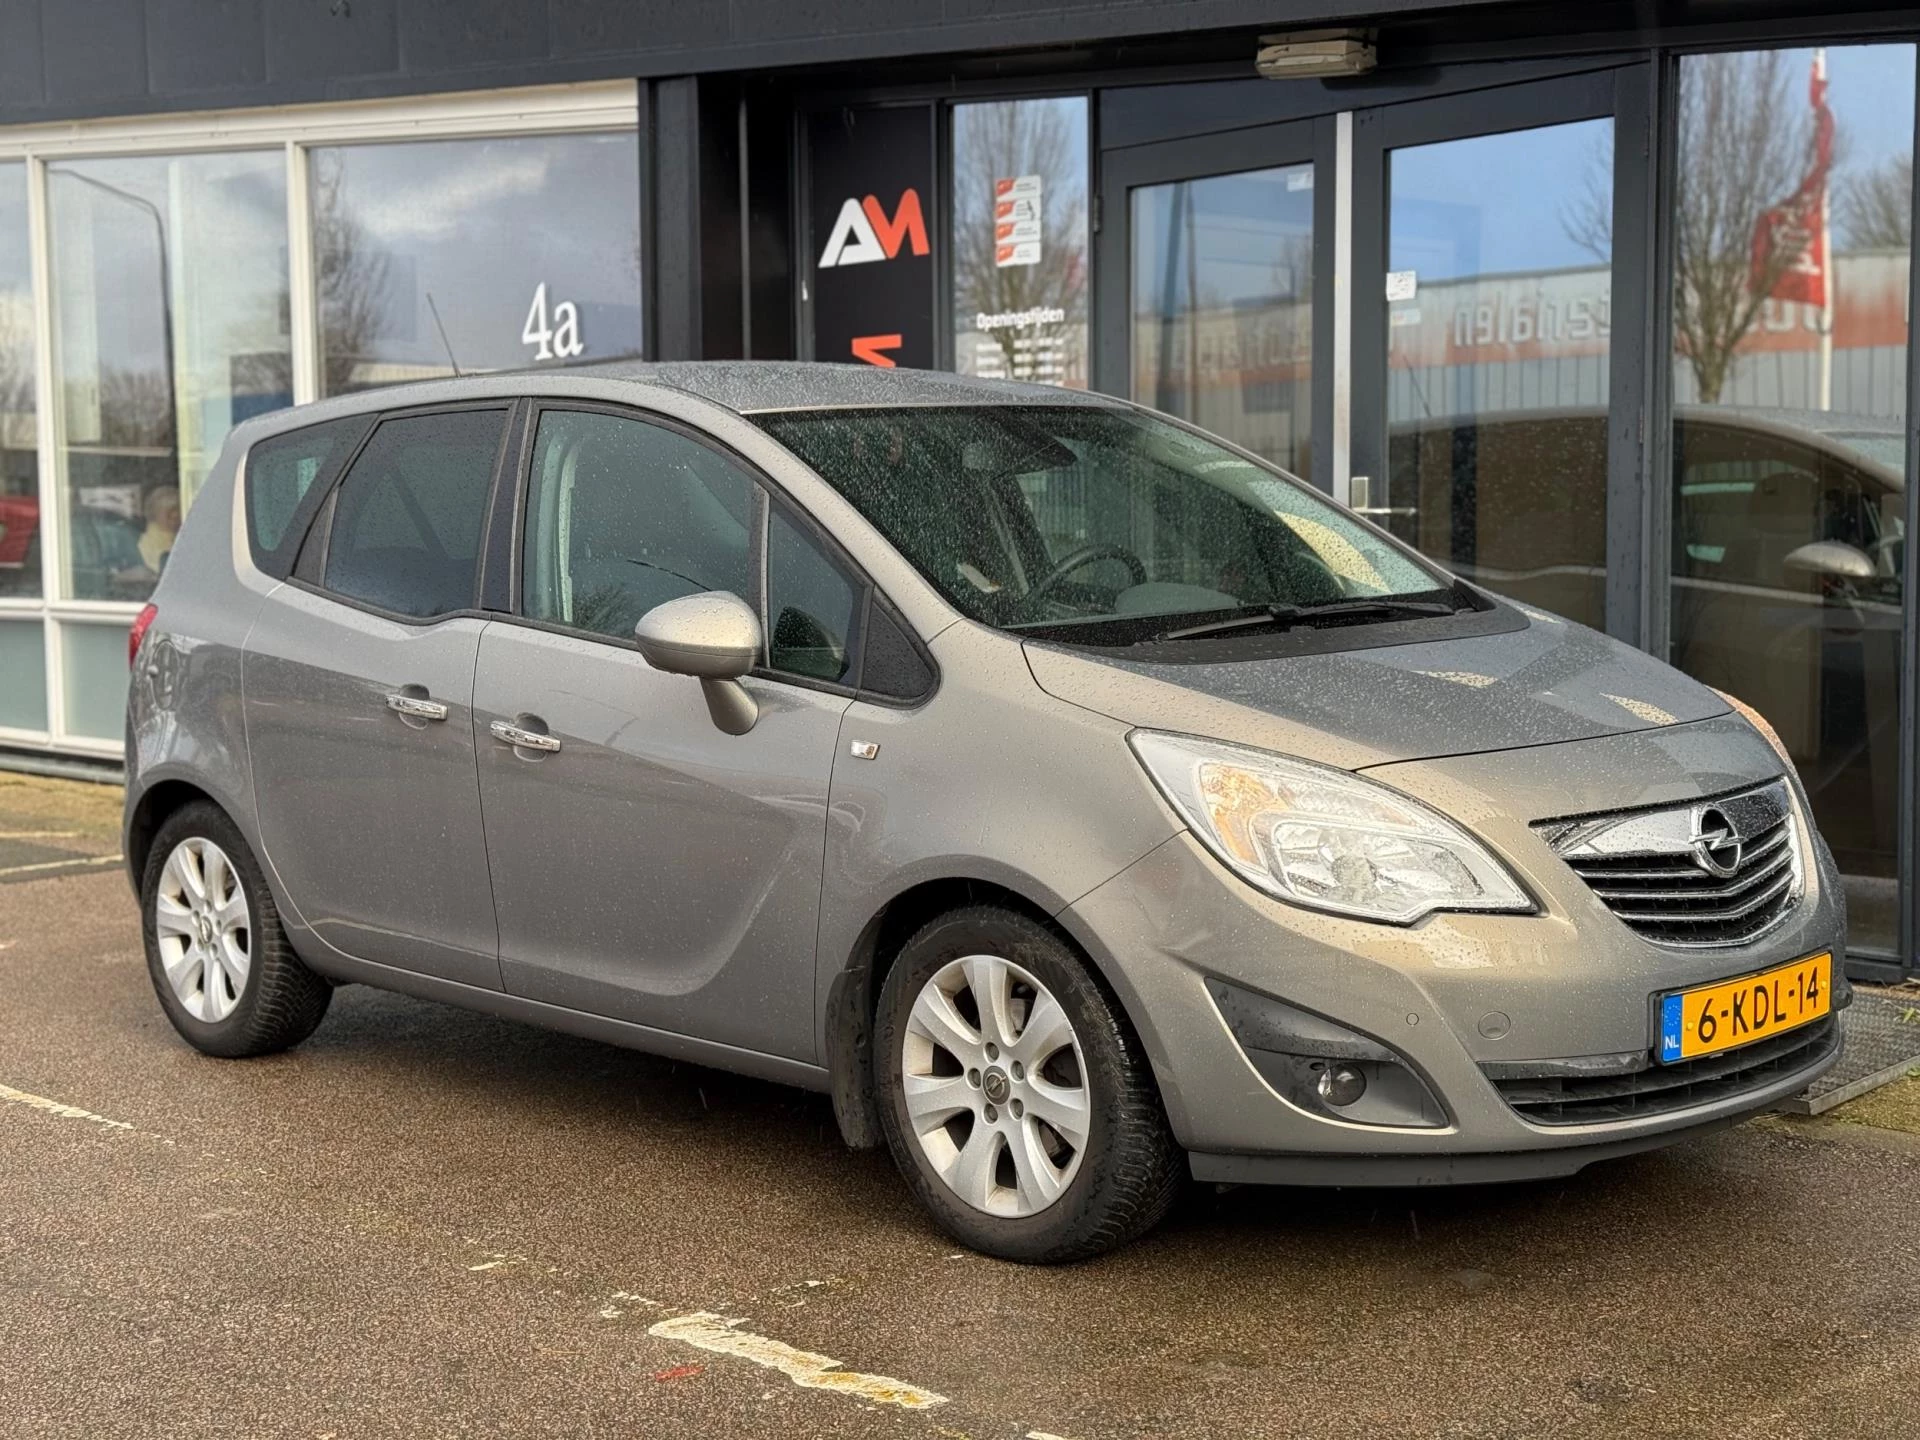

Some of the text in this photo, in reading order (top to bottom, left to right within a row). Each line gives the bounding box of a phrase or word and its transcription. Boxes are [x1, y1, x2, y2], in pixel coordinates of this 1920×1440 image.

[818, 188, 930, 268] AM
[522, 281, 584, 360] 4a
[976, 306, 1065, 332] Openingstijden
[1664, 1034, 1680, 1050] NL
[1697, 966, 1819, 1044] 6-KDL-14
